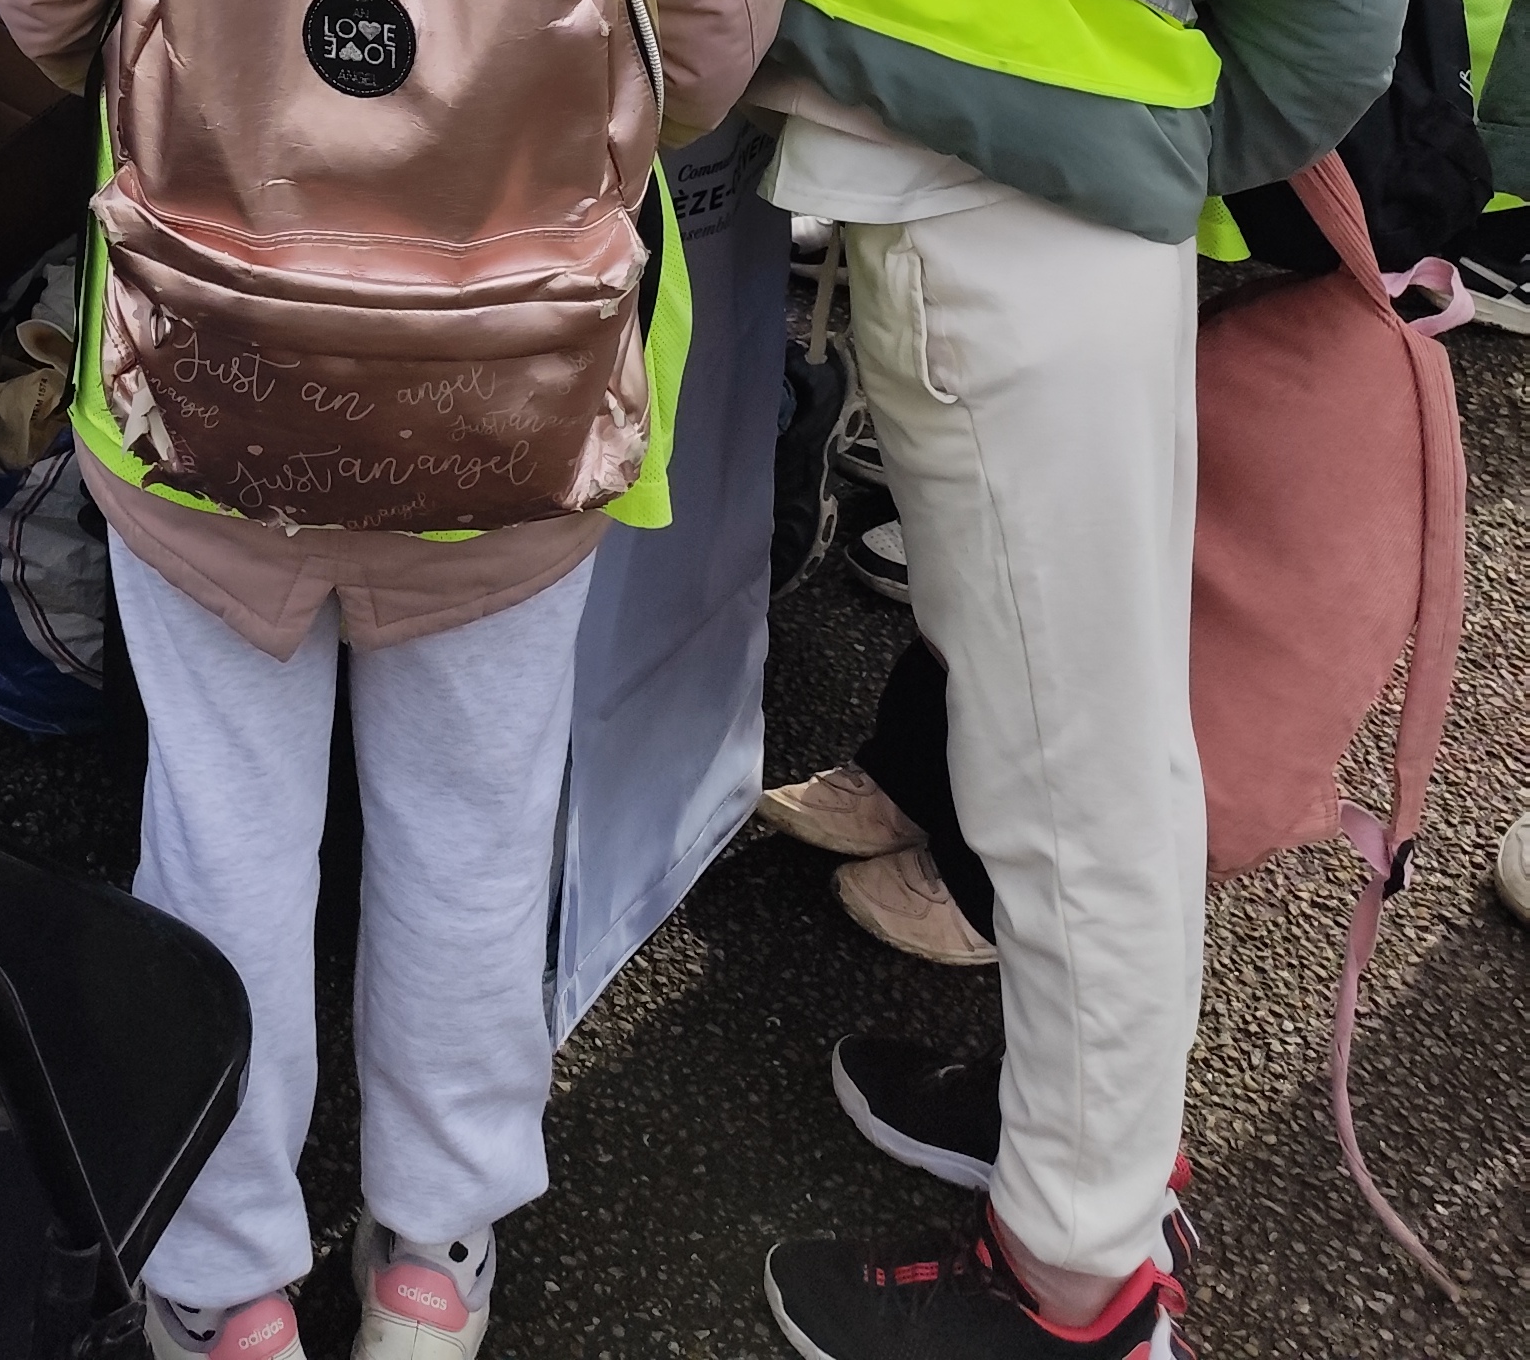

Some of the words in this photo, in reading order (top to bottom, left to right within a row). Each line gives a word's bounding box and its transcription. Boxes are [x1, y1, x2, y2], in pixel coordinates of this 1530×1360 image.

[173, 331, 301, 402] Just
[301, 381, 375, 421] an
[227, 444, 342, 508] Just
[338, 457, 414, 485] an
[417, 440, 538, 490] angel
[397, 1284, 448, 1311] adidas
[238, 1317, 285, 1350] adidas
